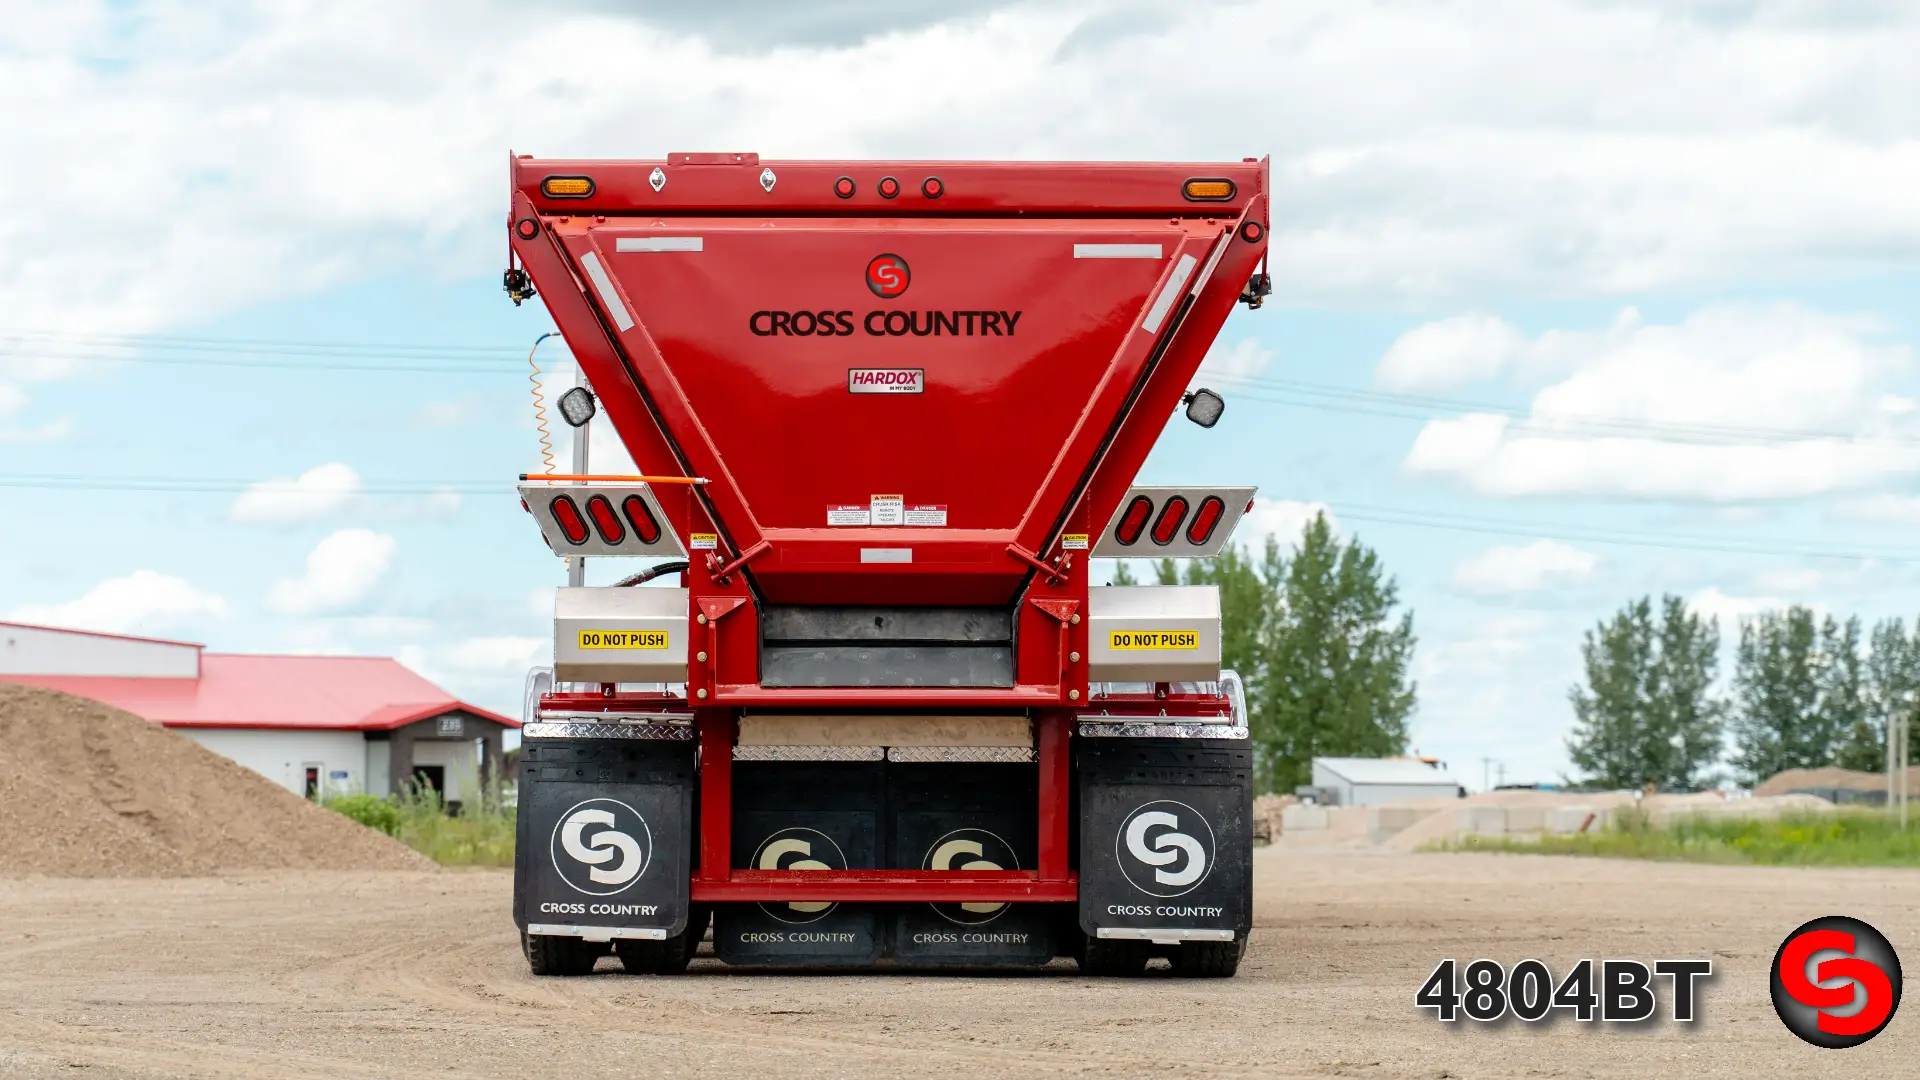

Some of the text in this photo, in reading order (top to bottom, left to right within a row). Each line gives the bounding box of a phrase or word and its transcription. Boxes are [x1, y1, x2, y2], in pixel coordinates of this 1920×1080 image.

[749, 310, 1022, 337] CROSS COUNTRY
[583, 634, 664, 646] DO NOT PUSH
[1113, 634, 1195, 646] DO NOT PUSH
[540, 902, 658, 916] CROSS COUNTRY
[1107, 905, 1223, 917] CROSS COUNTRY
[740, 932, 856, 944] CROSS COUNTRY
[913, 933, 1029, 944] CROSS COUNTRY
